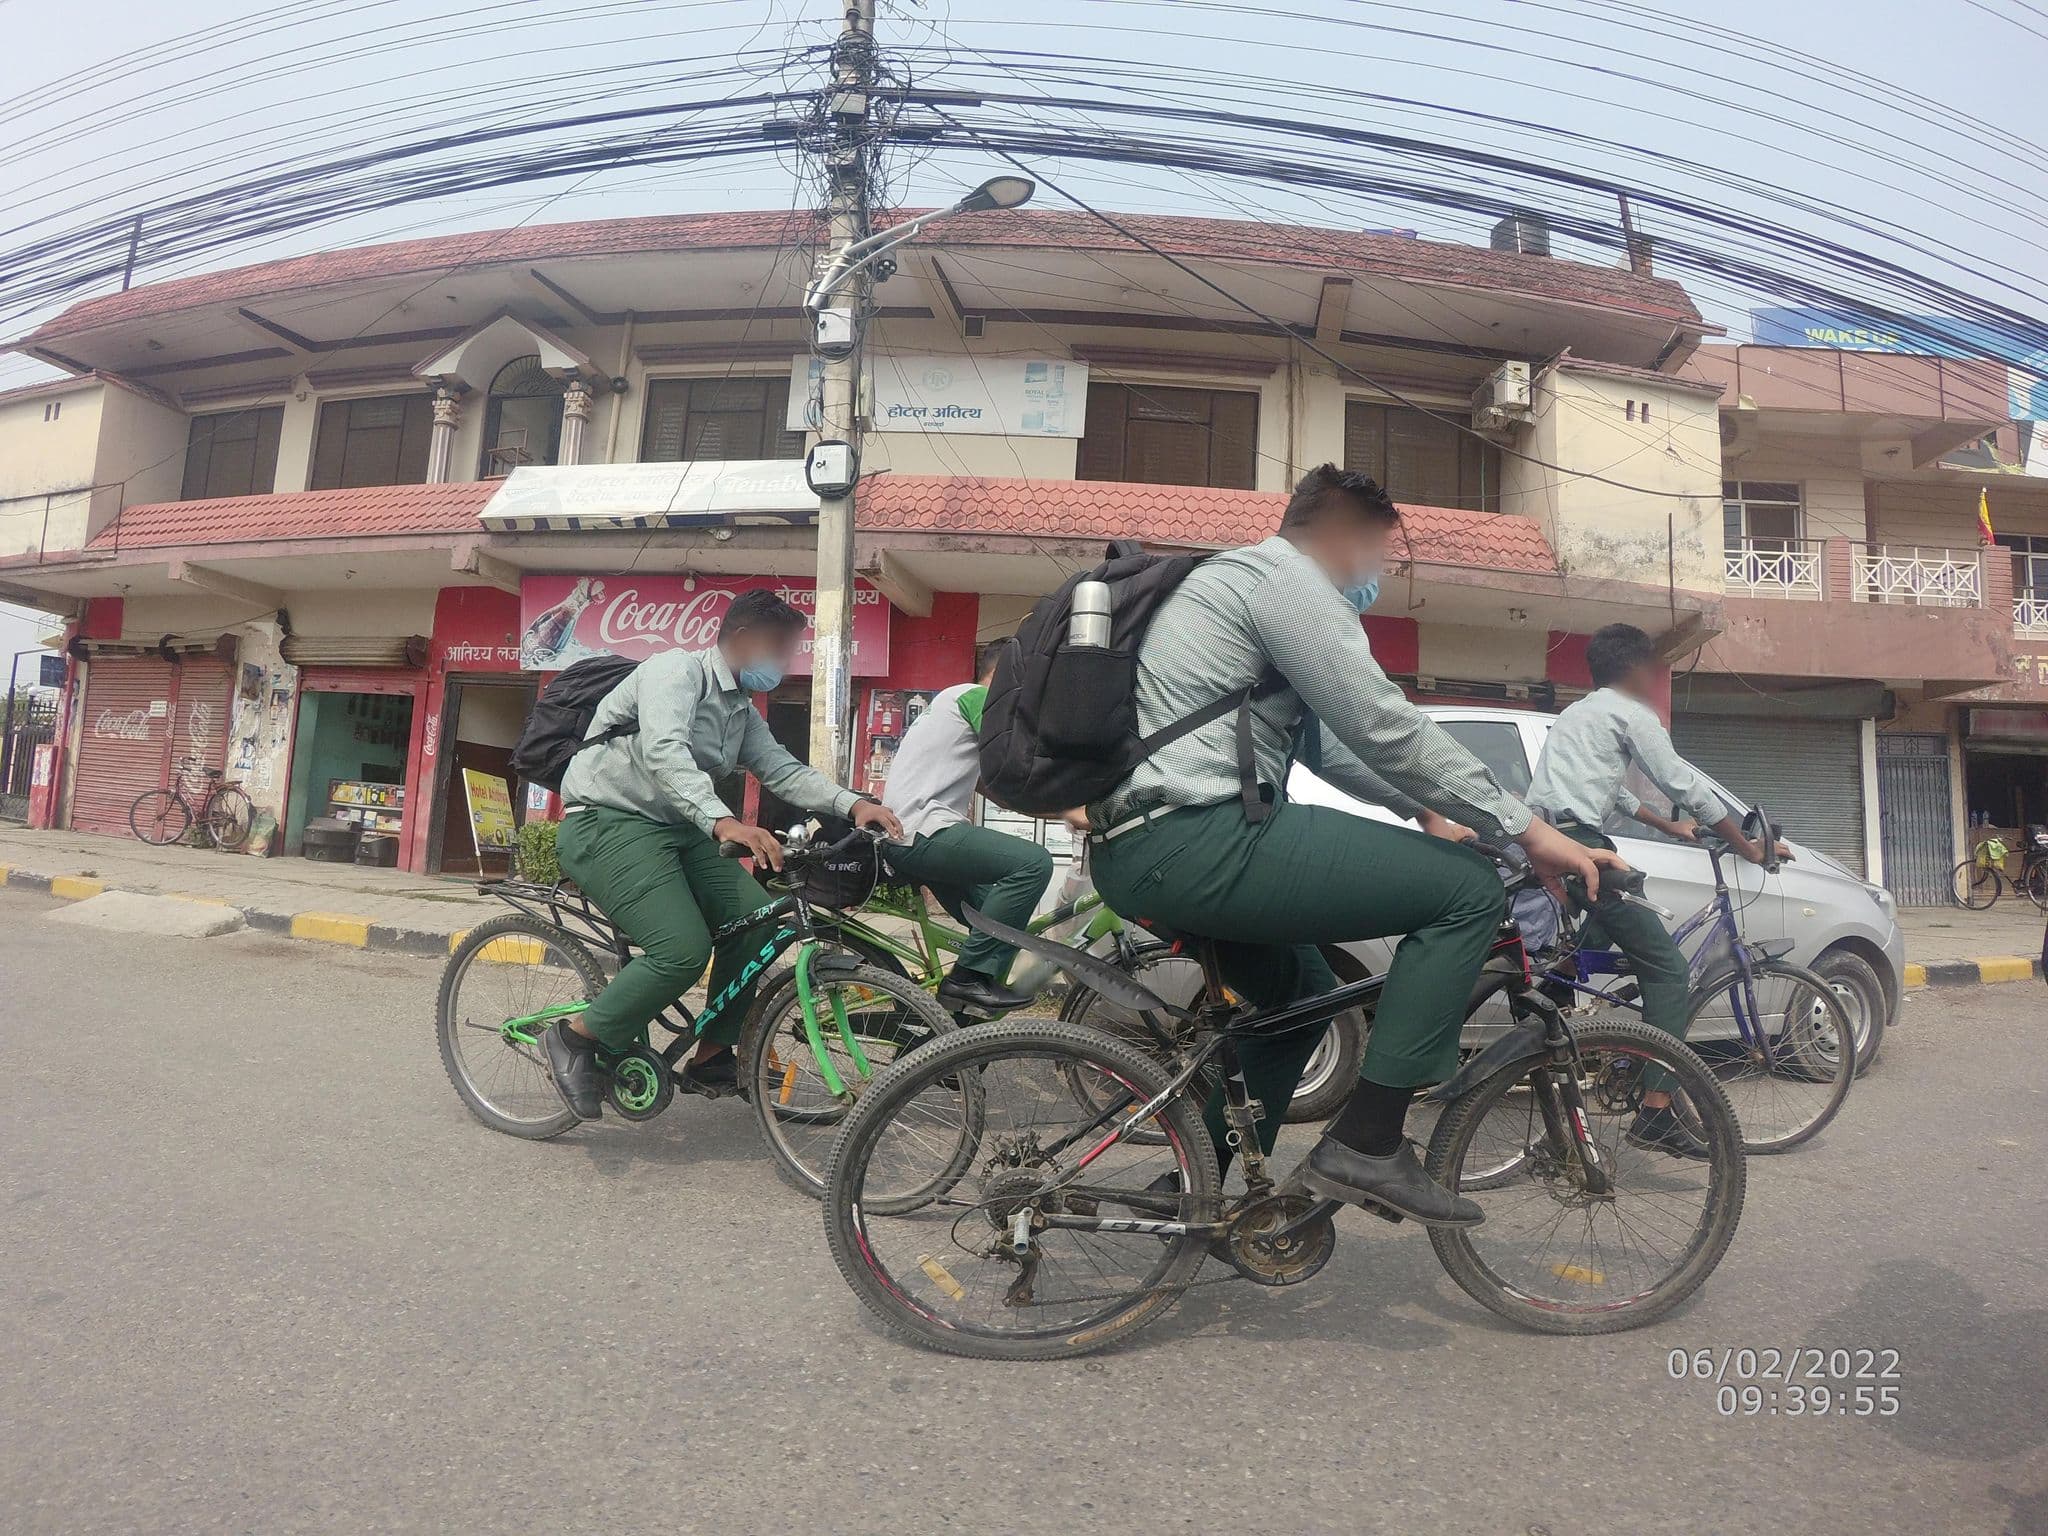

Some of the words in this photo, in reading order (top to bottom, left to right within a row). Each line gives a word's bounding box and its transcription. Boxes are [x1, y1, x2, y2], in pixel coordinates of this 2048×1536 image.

[1805, 328, 1868, 344] WAKE
[888, 404, 928, 418] होटल
[600, 590, 735, 645] Coca-Co
[694, 939, 776, 1037] ATLAS
